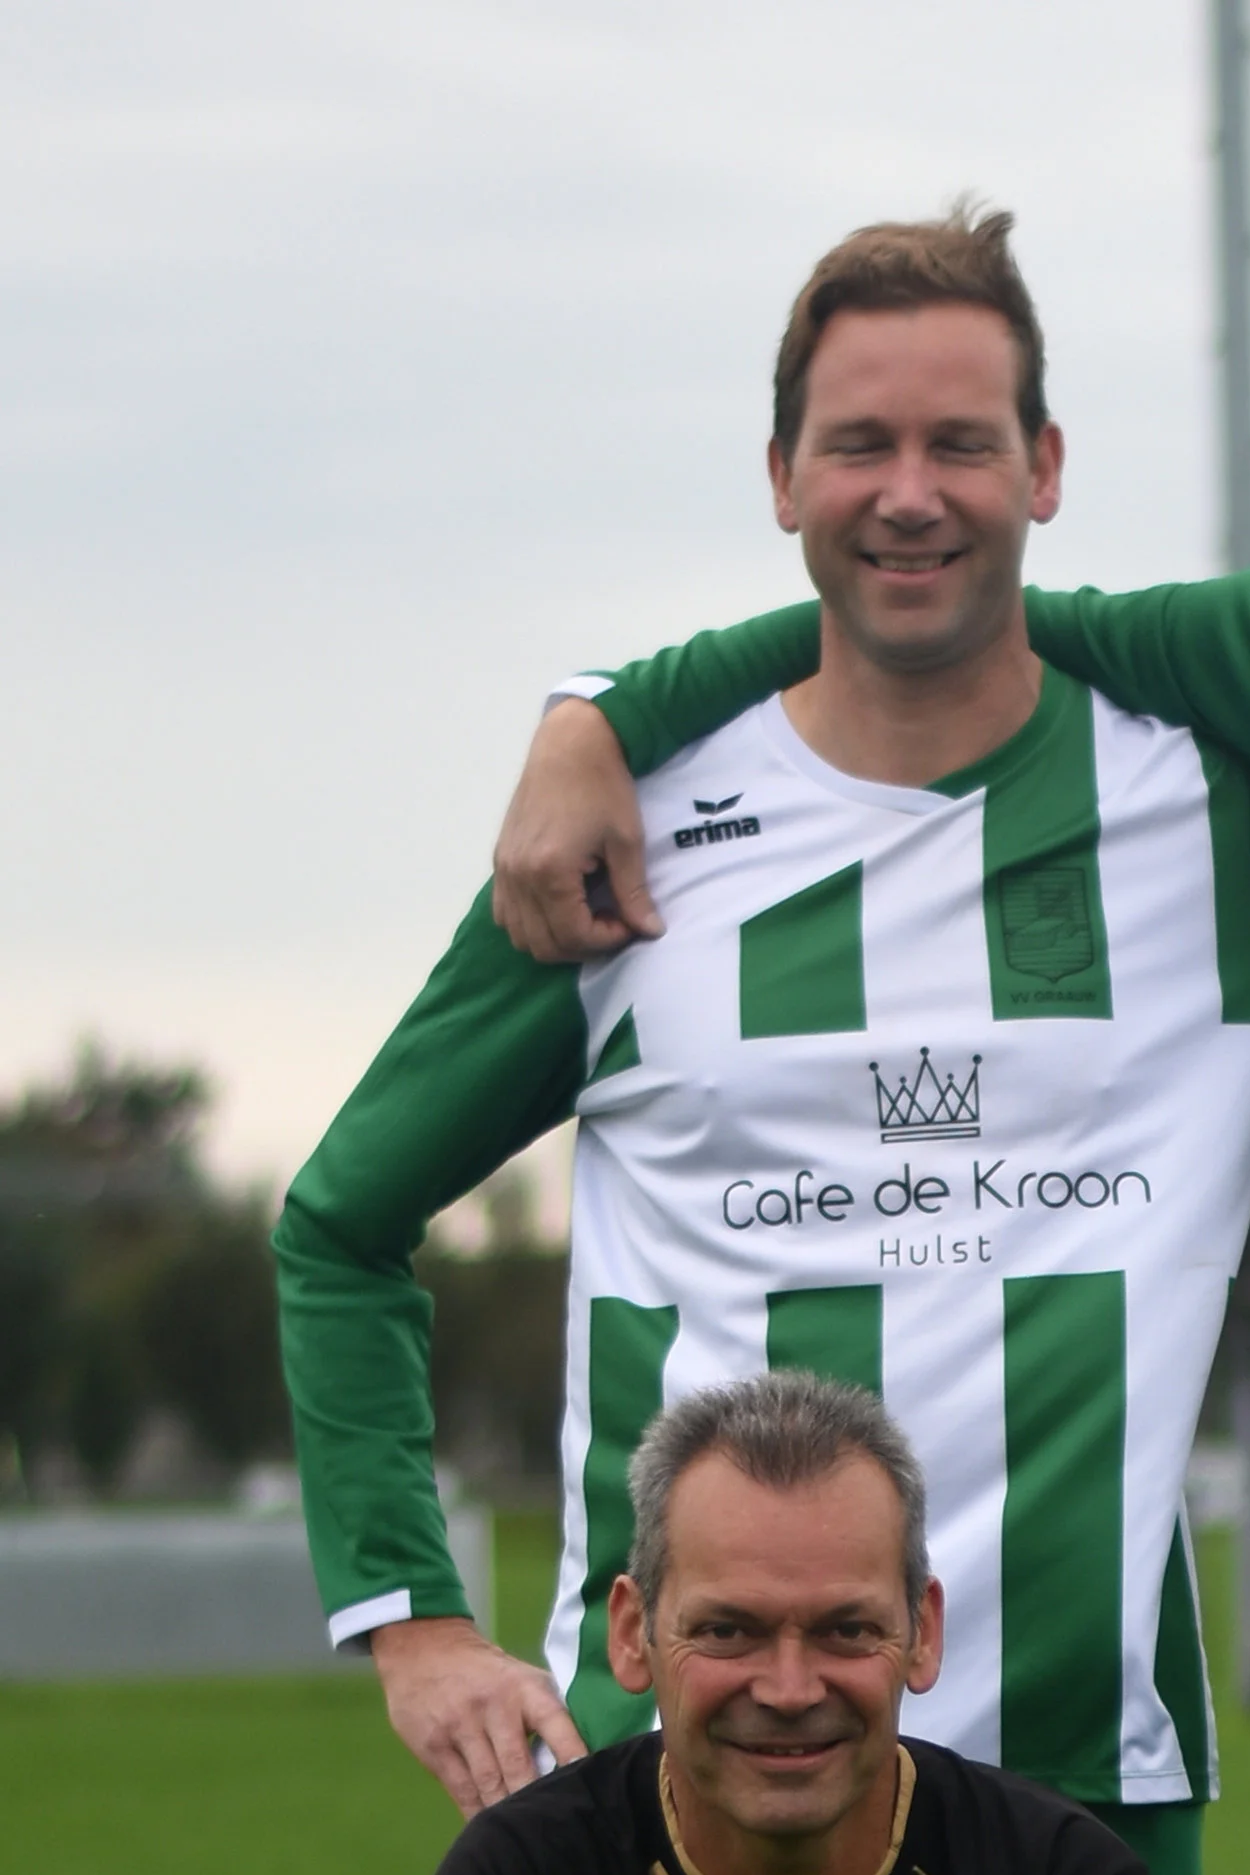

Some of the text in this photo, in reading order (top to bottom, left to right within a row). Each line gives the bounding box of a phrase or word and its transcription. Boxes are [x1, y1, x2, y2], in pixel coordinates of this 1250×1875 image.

[674, 814, 760, 849] erima
[723, 1158, 1151, 1230] Cafe de Kroon
[880, 1234, 992, 1268] Hulst
